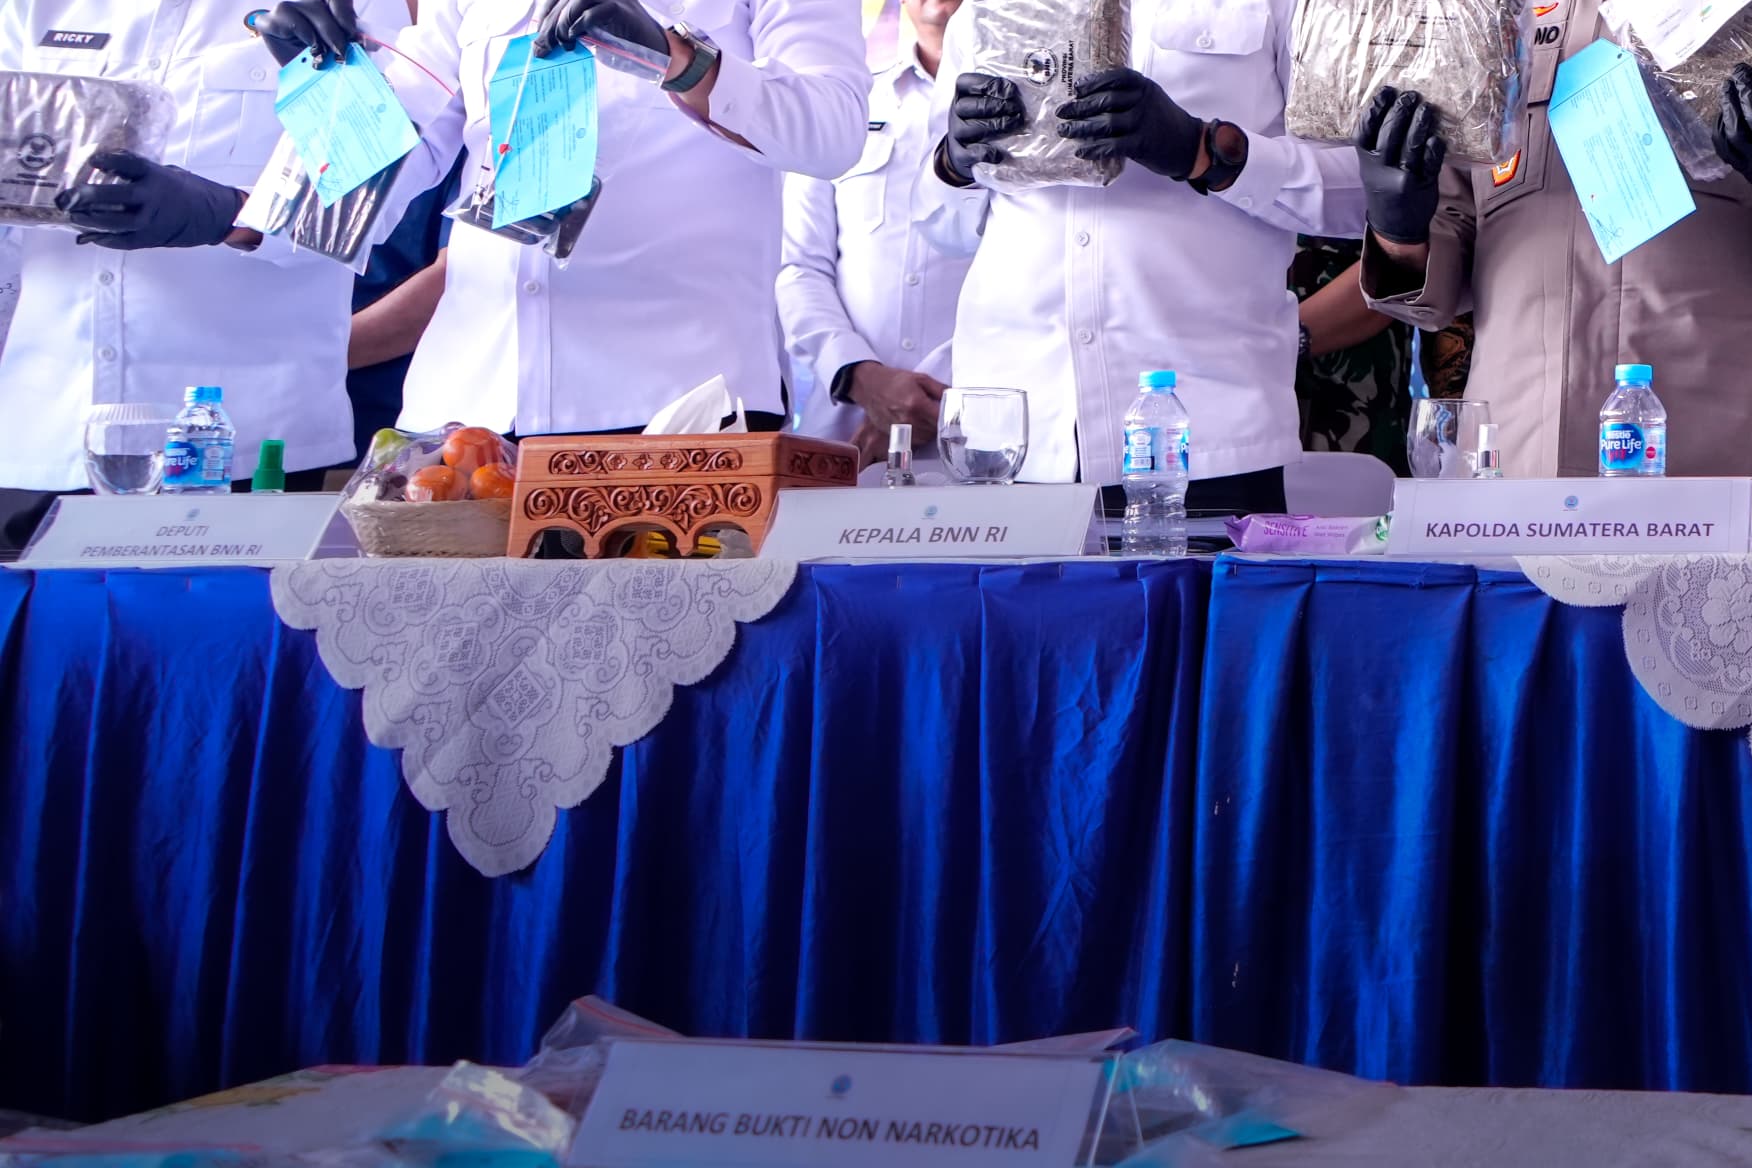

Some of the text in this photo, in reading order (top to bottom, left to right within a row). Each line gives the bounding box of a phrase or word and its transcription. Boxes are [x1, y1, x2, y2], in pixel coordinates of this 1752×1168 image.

[53, 33, 94, 43] RICKY
[1601, 438, 1641, 453] Pure Life
[156, 525, 209, 537] DEPUTI
[838, 526, 1009, 544] KEPALA BNN RI
[1425, 522, 1715, 538] KAPOLDA SUMATERA BARAT
[80, 544, 263, 558] PEMBERANTASAN BNN RI
[619, 1108, 1040, 1150] BARANG BUKTI NON NARKOTIKA
